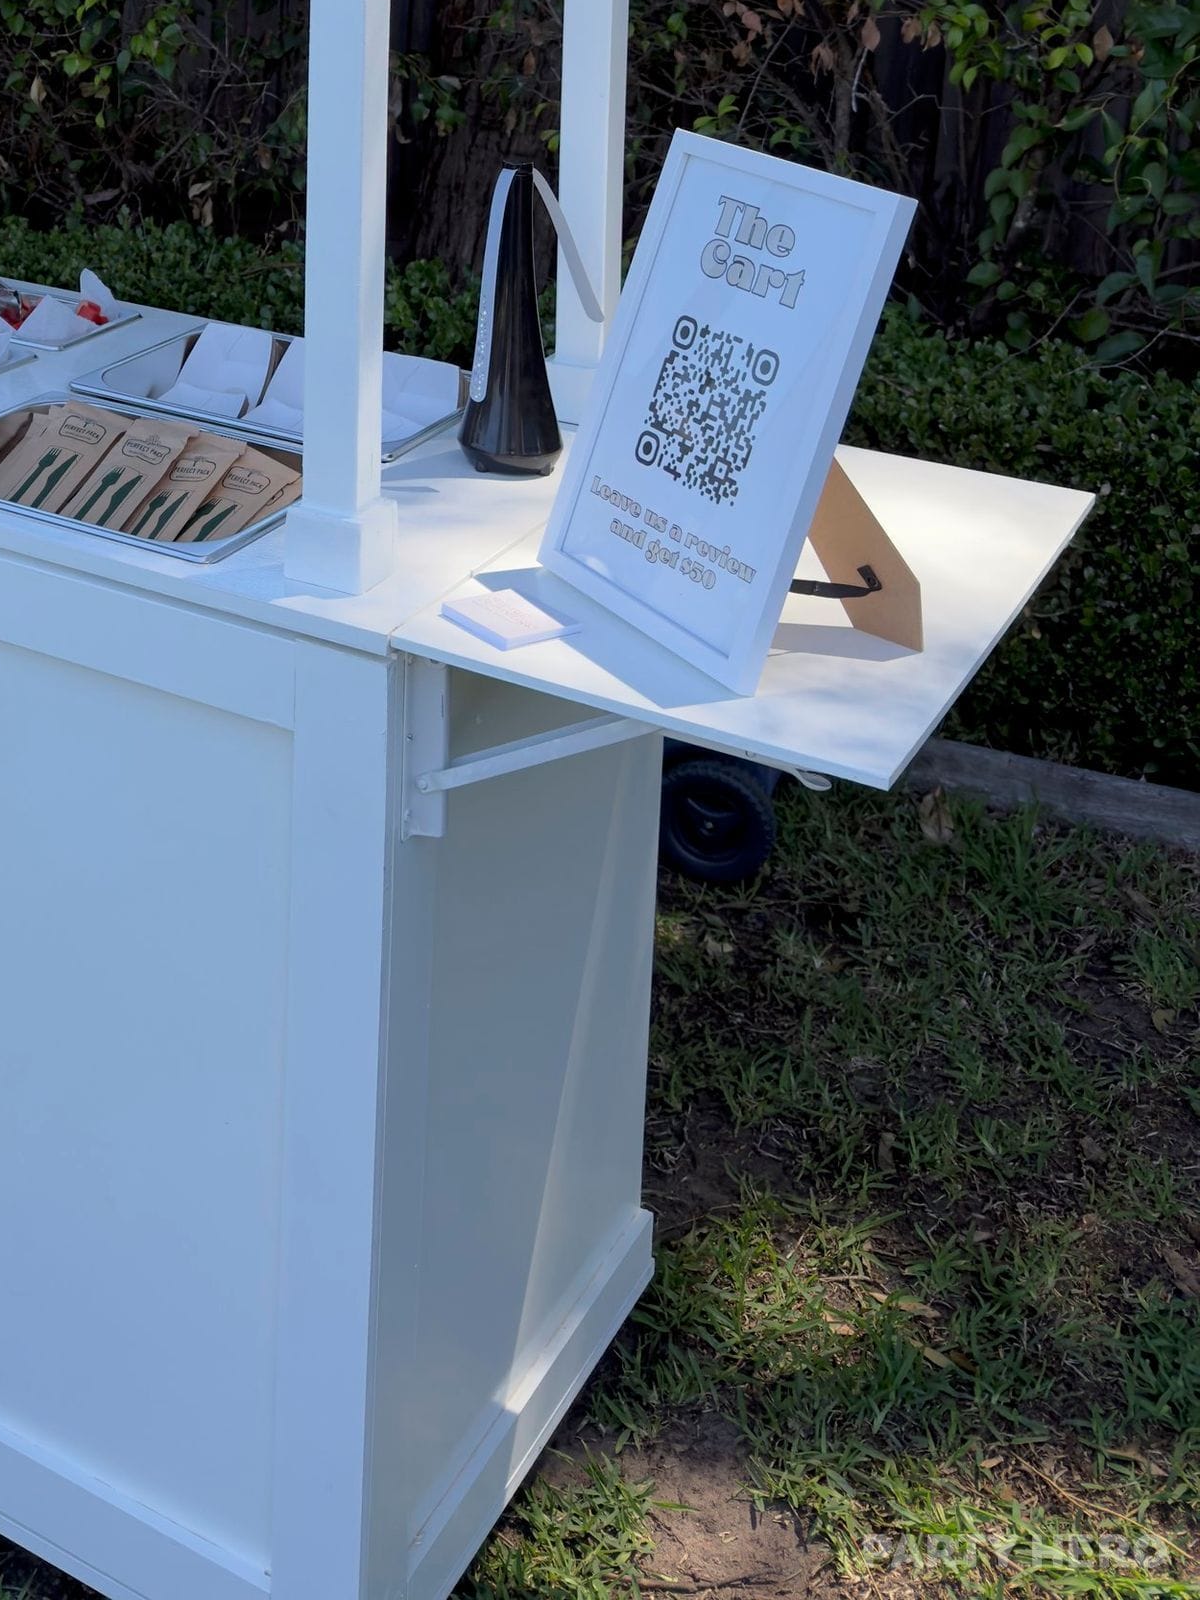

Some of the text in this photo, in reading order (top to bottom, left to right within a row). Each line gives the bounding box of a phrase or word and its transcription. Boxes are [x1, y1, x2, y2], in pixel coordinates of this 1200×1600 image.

[714, 195, 796, 258] The
[700, 238, 806, 309] Cart
[590, 475, 757, 584] Leave us a review
[610, 518, 716, 590] and get $50
